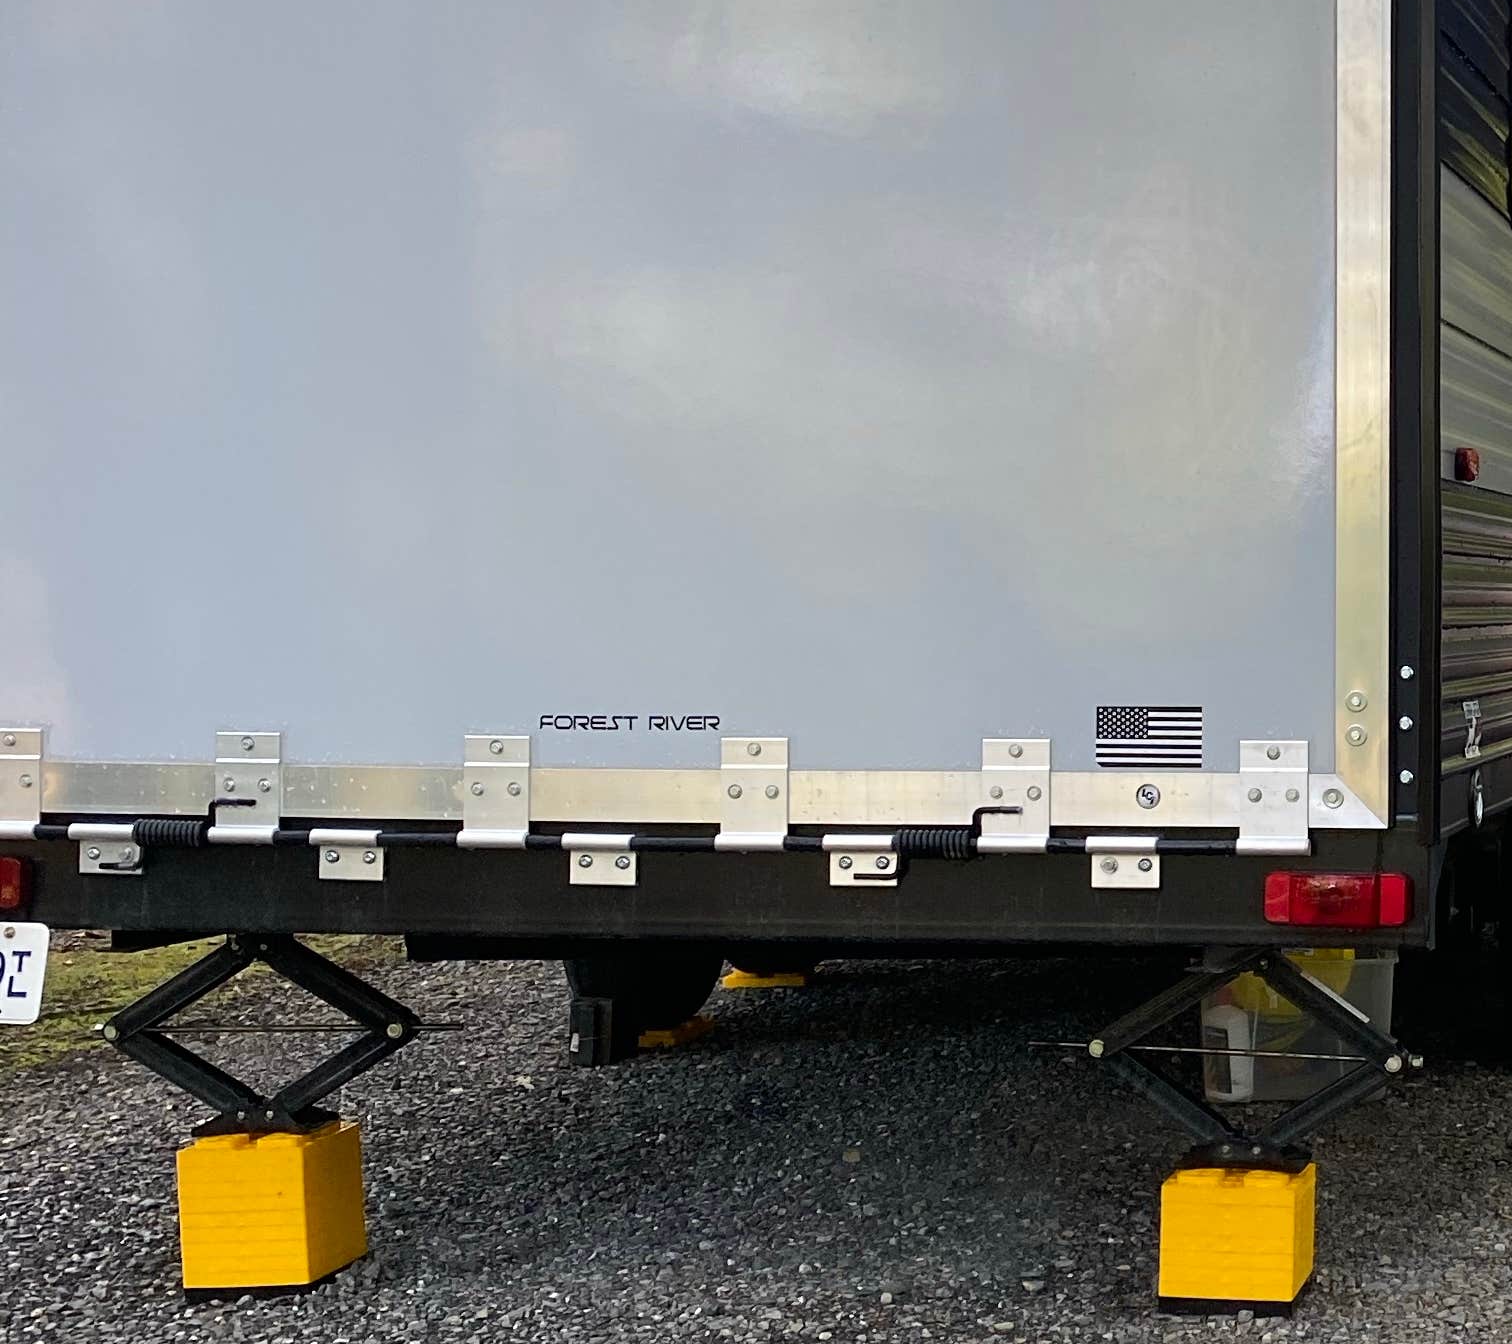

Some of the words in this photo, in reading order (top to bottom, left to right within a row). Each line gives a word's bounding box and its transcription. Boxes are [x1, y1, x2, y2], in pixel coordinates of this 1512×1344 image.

[539, 715, 638, 730] FOREST
[648, 715, 720, 731] RIVER
[12, 950, 32, 973] T
[7, 975, 27, 998] L
